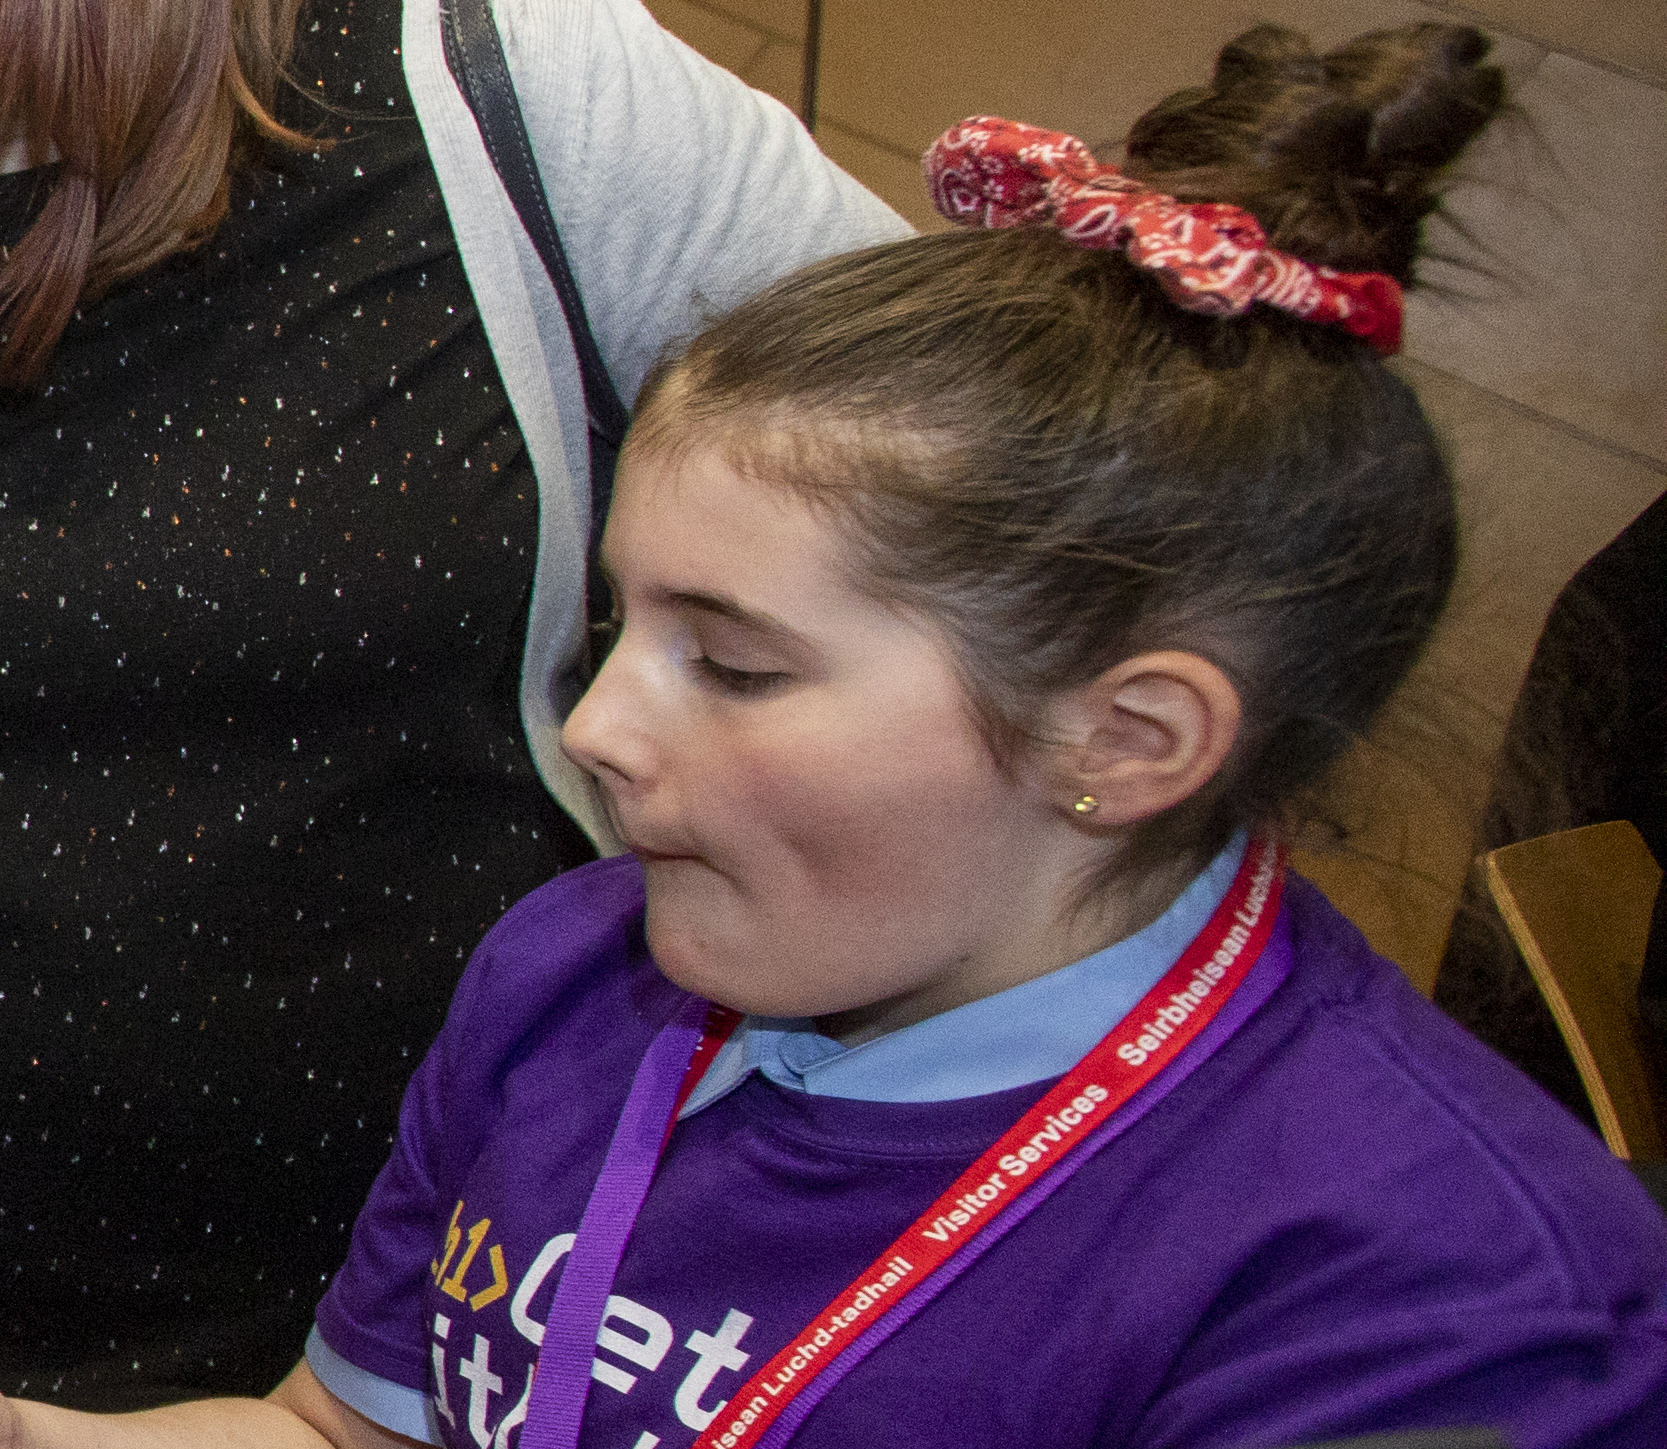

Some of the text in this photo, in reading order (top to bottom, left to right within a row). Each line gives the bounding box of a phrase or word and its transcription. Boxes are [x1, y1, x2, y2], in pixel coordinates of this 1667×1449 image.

[922, 930, 1252, 1245] Visitor Services Seirbheisean
[762, 1255, 915, 1398] Luchd-tadhail
